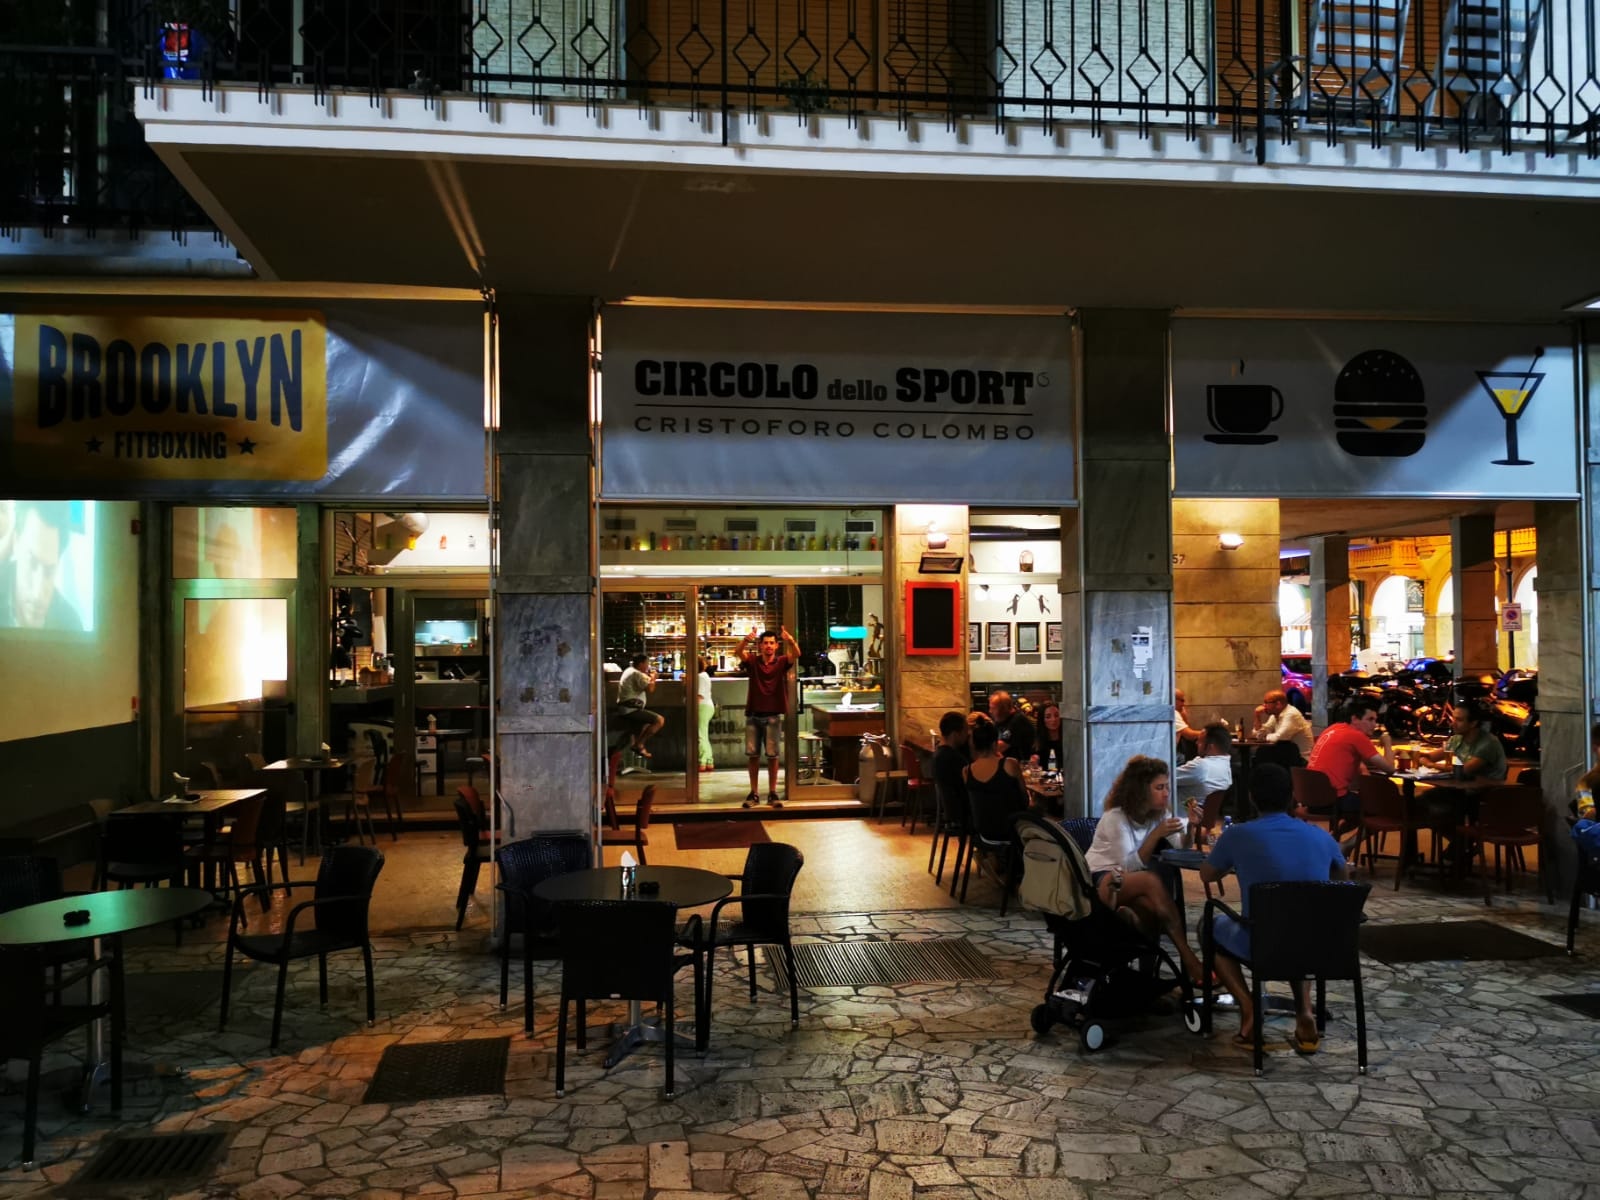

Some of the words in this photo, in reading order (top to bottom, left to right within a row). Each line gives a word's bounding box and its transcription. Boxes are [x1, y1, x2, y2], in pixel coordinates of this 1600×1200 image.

[39, 324, 302, 432] BROOKLYN
[635, 360, 818, 400] CIRCOLO
[827, 379, 887, 401] dello
[896, 367, 1033, 405] SPORT
[115, 432, 227, 459] FITBOXING
[635, 416, 855, 437] CRISTOFORO
[873, 422, 1034, 441] COLOMBO
